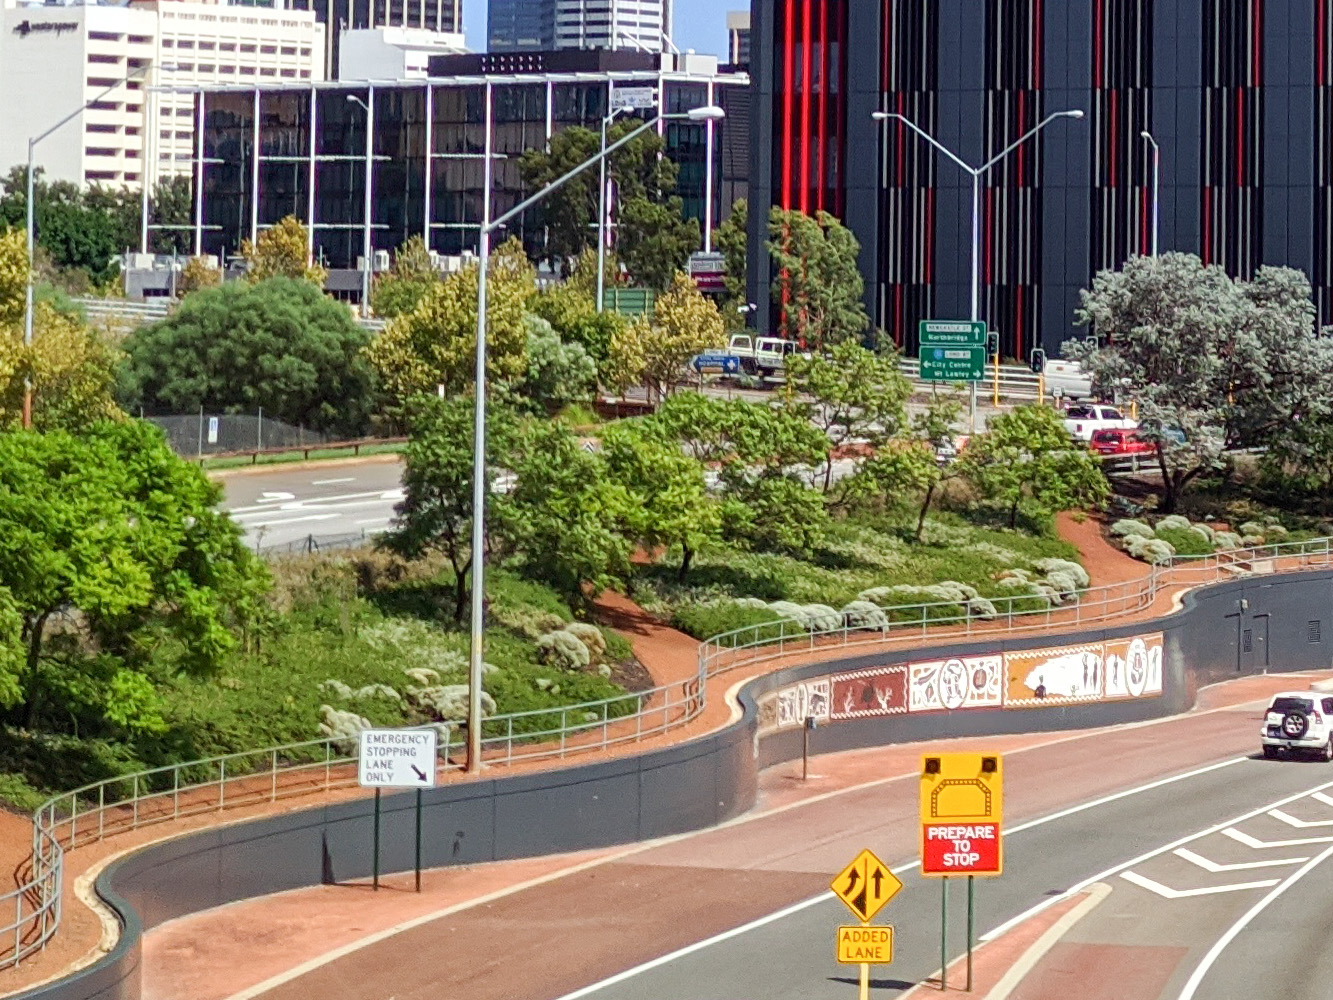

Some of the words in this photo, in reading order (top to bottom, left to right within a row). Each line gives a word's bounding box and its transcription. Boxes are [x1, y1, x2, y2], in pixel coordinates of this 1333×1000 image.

[366, 734, 429, 744] EMERGENCY
[366, 747, 417, 757] STOPPING
[365, 759, 394, 770] LANE
[366, 772, 395, 782] ONLY
[928, 826, 995, 839] PREPARE
[952, 839, 971, 853] TO
[943, 853, 980, 866] STOP
[842, 930, 889, 943] ADDED
[846, 947, 883, 959] LANE
